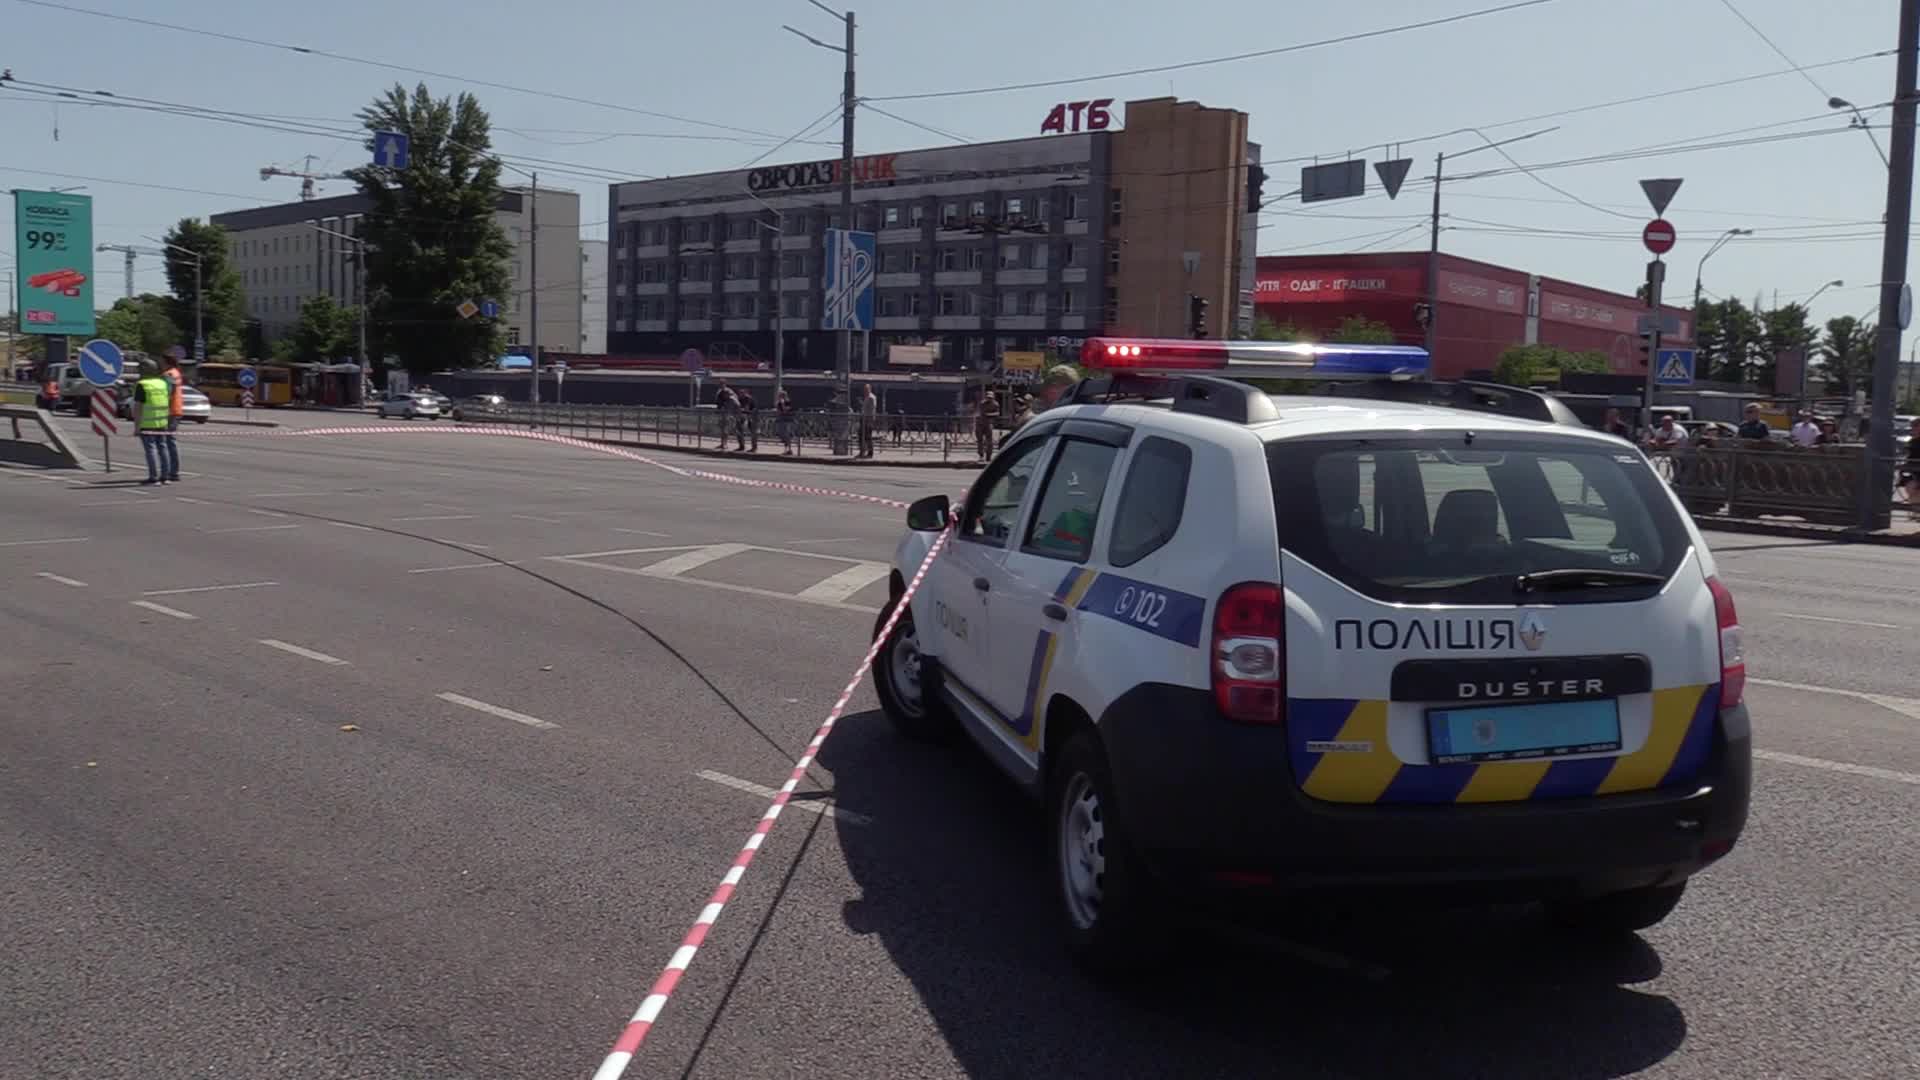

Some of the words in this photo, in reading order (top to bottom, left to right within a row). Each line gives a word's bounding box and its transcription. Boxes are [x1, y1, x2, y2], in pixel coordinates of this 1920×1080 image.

[1255, 280, 1280, 292] УТТЯ
[1130, 590, 1167, 627] 102
[1335, 619, 1515, 650] ПОЛІЦІЯ
[1458, 679, 1604, 698] DUSTER
